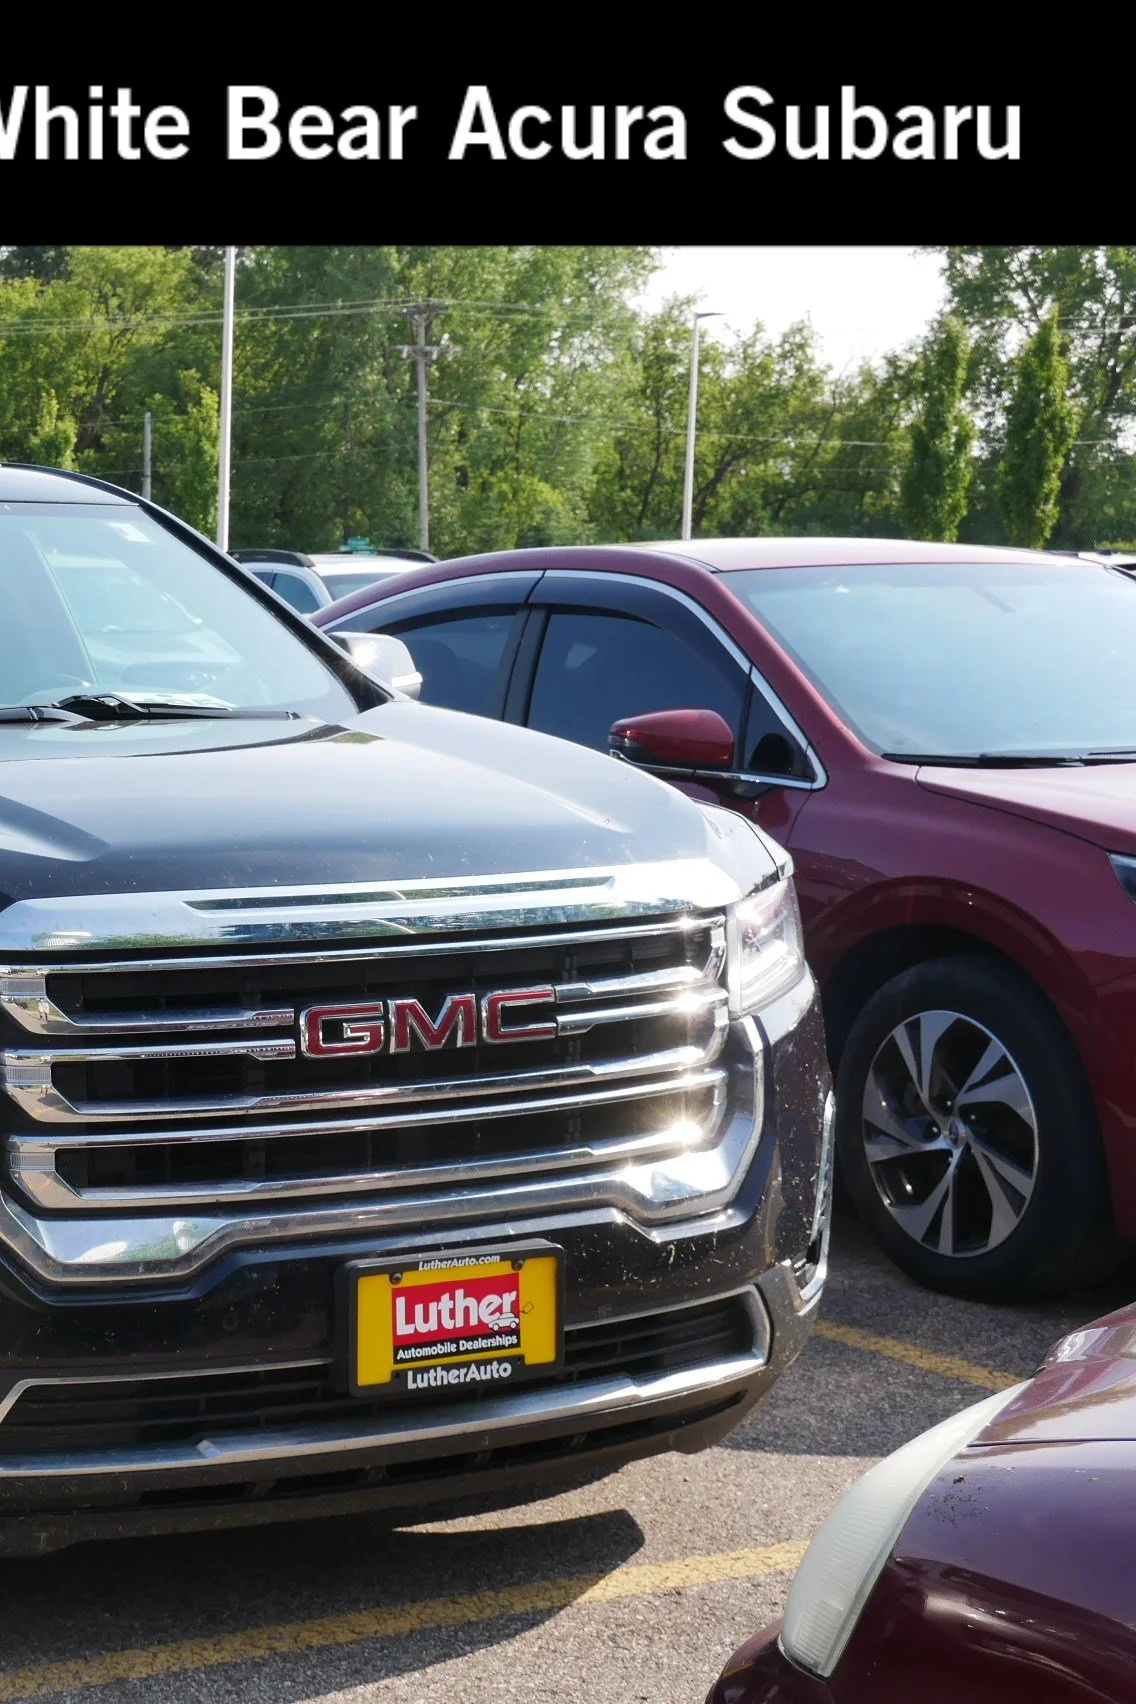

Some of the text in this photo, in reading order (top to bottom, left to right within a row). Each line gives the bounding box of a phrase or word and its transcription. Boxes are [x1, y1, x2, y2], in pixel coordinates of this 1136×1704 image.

[299, 984, 558, 1059] GMC
[418, 1254, 501, 1271] LutherAuto.com
[395, 1288, 518, 1336] Luther
[396, 1333, 518, 1360] Automobile Dealerships
[407, 1360, 512, 1390] LutherAuto
